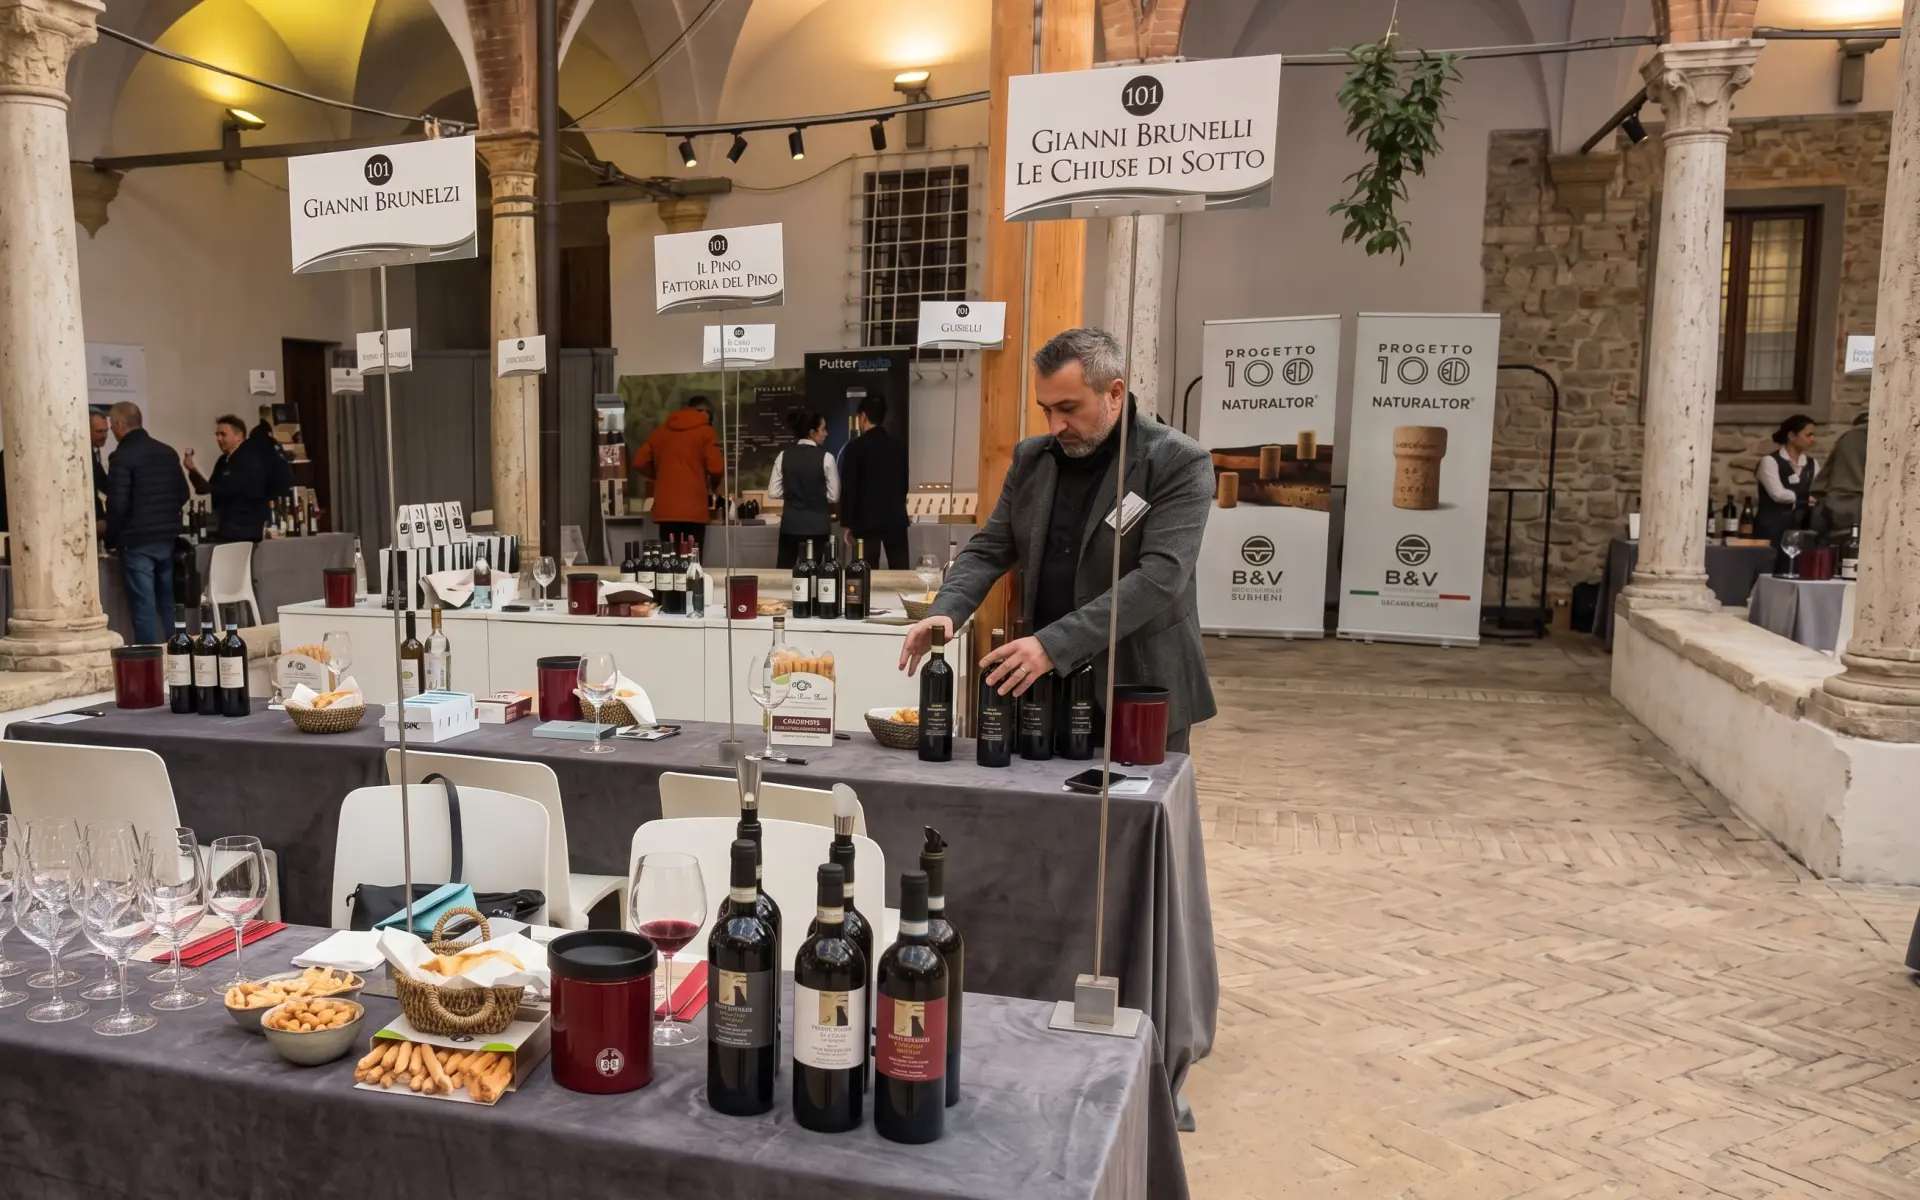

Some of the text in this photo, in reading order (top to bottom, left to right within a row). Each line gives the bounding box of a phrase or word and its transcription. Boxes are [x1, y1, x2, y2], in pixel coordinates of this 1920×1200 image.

[1125, 84, 1159, 107] 101
[1031, 119, 1253, 153] GIANNI BRUNELLI
[367, 161, 390, 179] 101
[1016, 149, 1265, 186] LE CHIUSE DI SOTTO
[303, 185, 461, 218] GIANNI BRUNELZI
[710, 239, 727, 252] 101
[697, 260, 741, 275] IL PINO
[662, 273, 778, 294] FATTORIA DEL PINO
[1225, 345, 1316, 358] PROGETTO
[1378, 343, 1473, 354] PROGETTO
[1232, 570, 1284, 585] B&V
[1385, 570, 1439, 586] B&V
